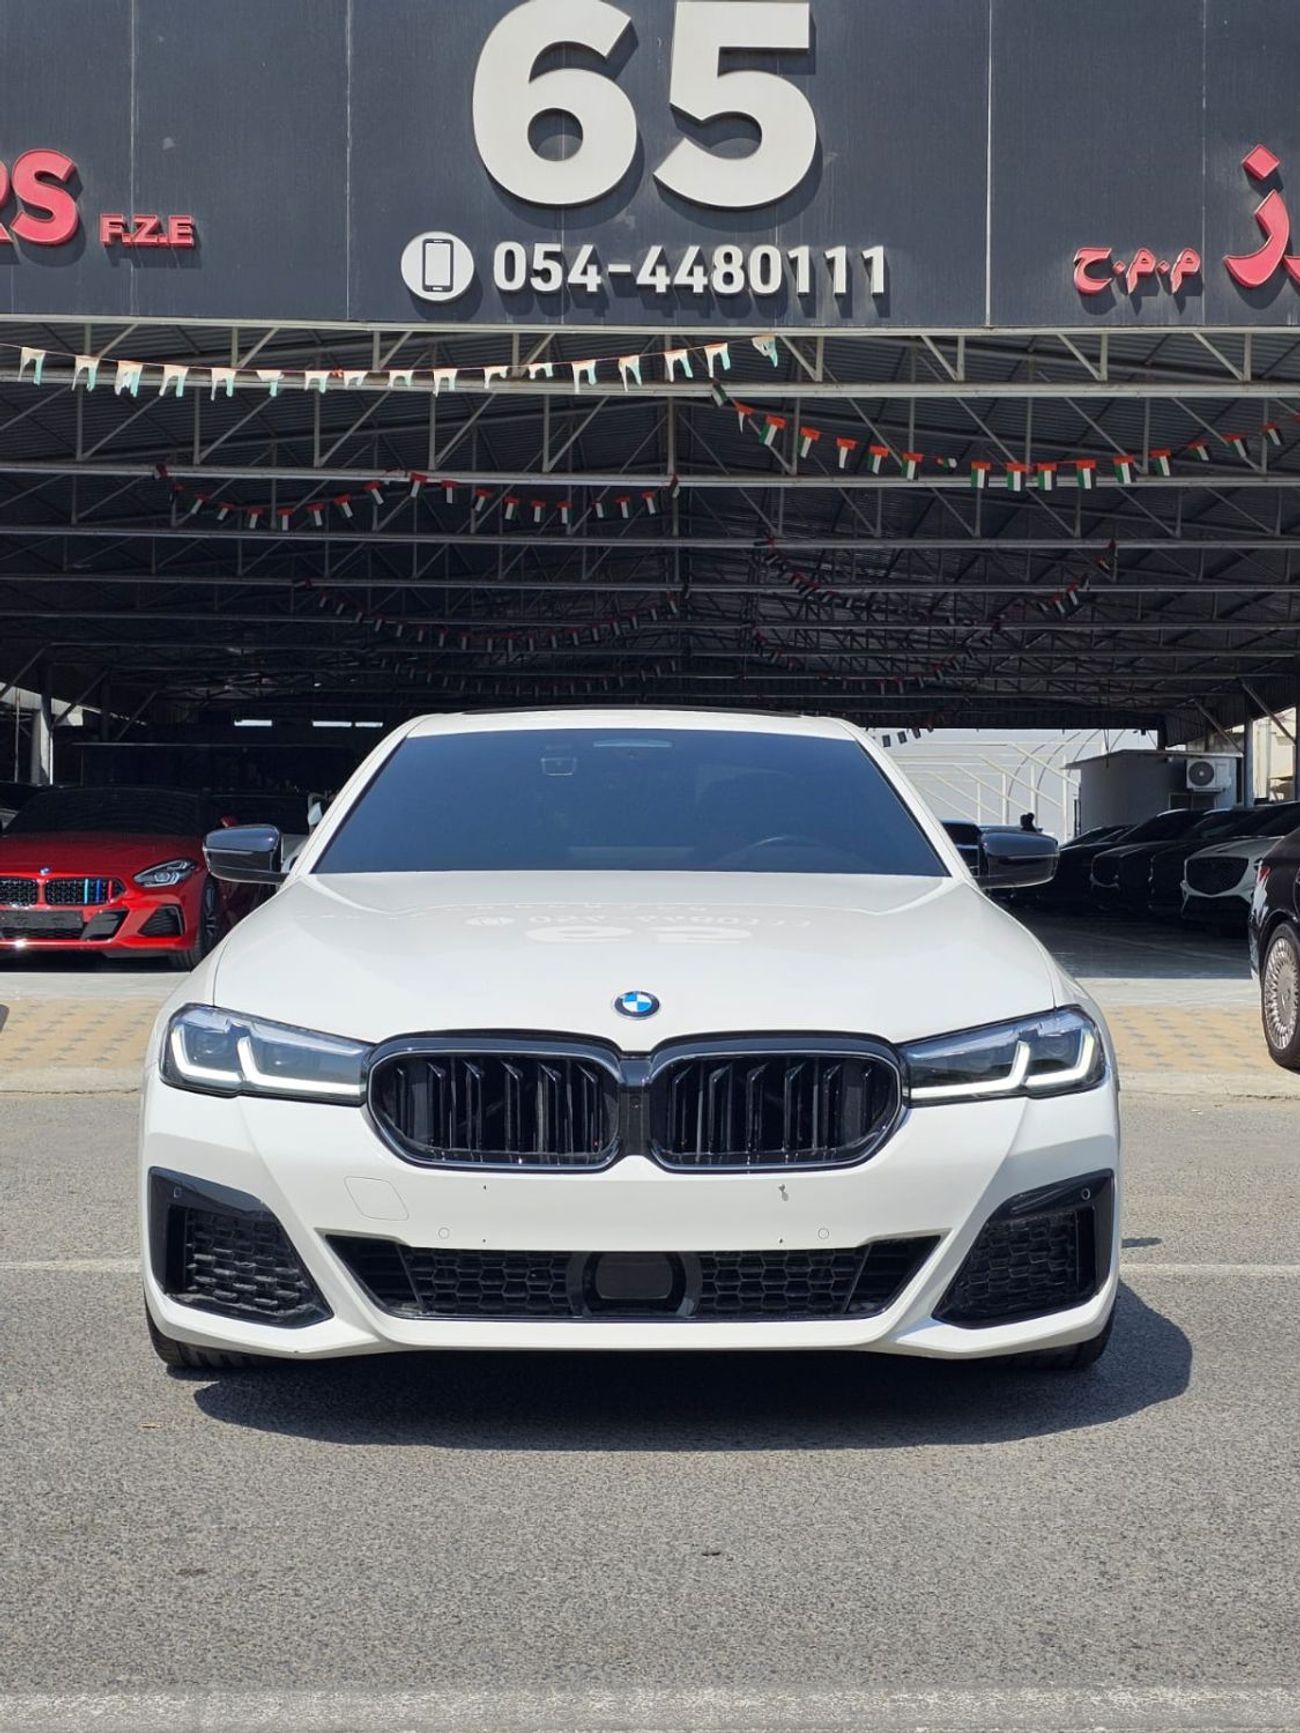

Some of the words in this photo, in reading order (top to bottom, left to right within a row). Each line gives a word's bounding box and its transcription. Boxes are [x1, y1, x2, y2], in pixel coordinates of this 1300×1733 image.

[472, 0, 817, 208] 65
[0, 148, 80, 246] S
[100, 213, 194, 248] F.Z.E
[1223, 144, 1300, 288] ز
[493, 241, 886, 296] 054-4480111
